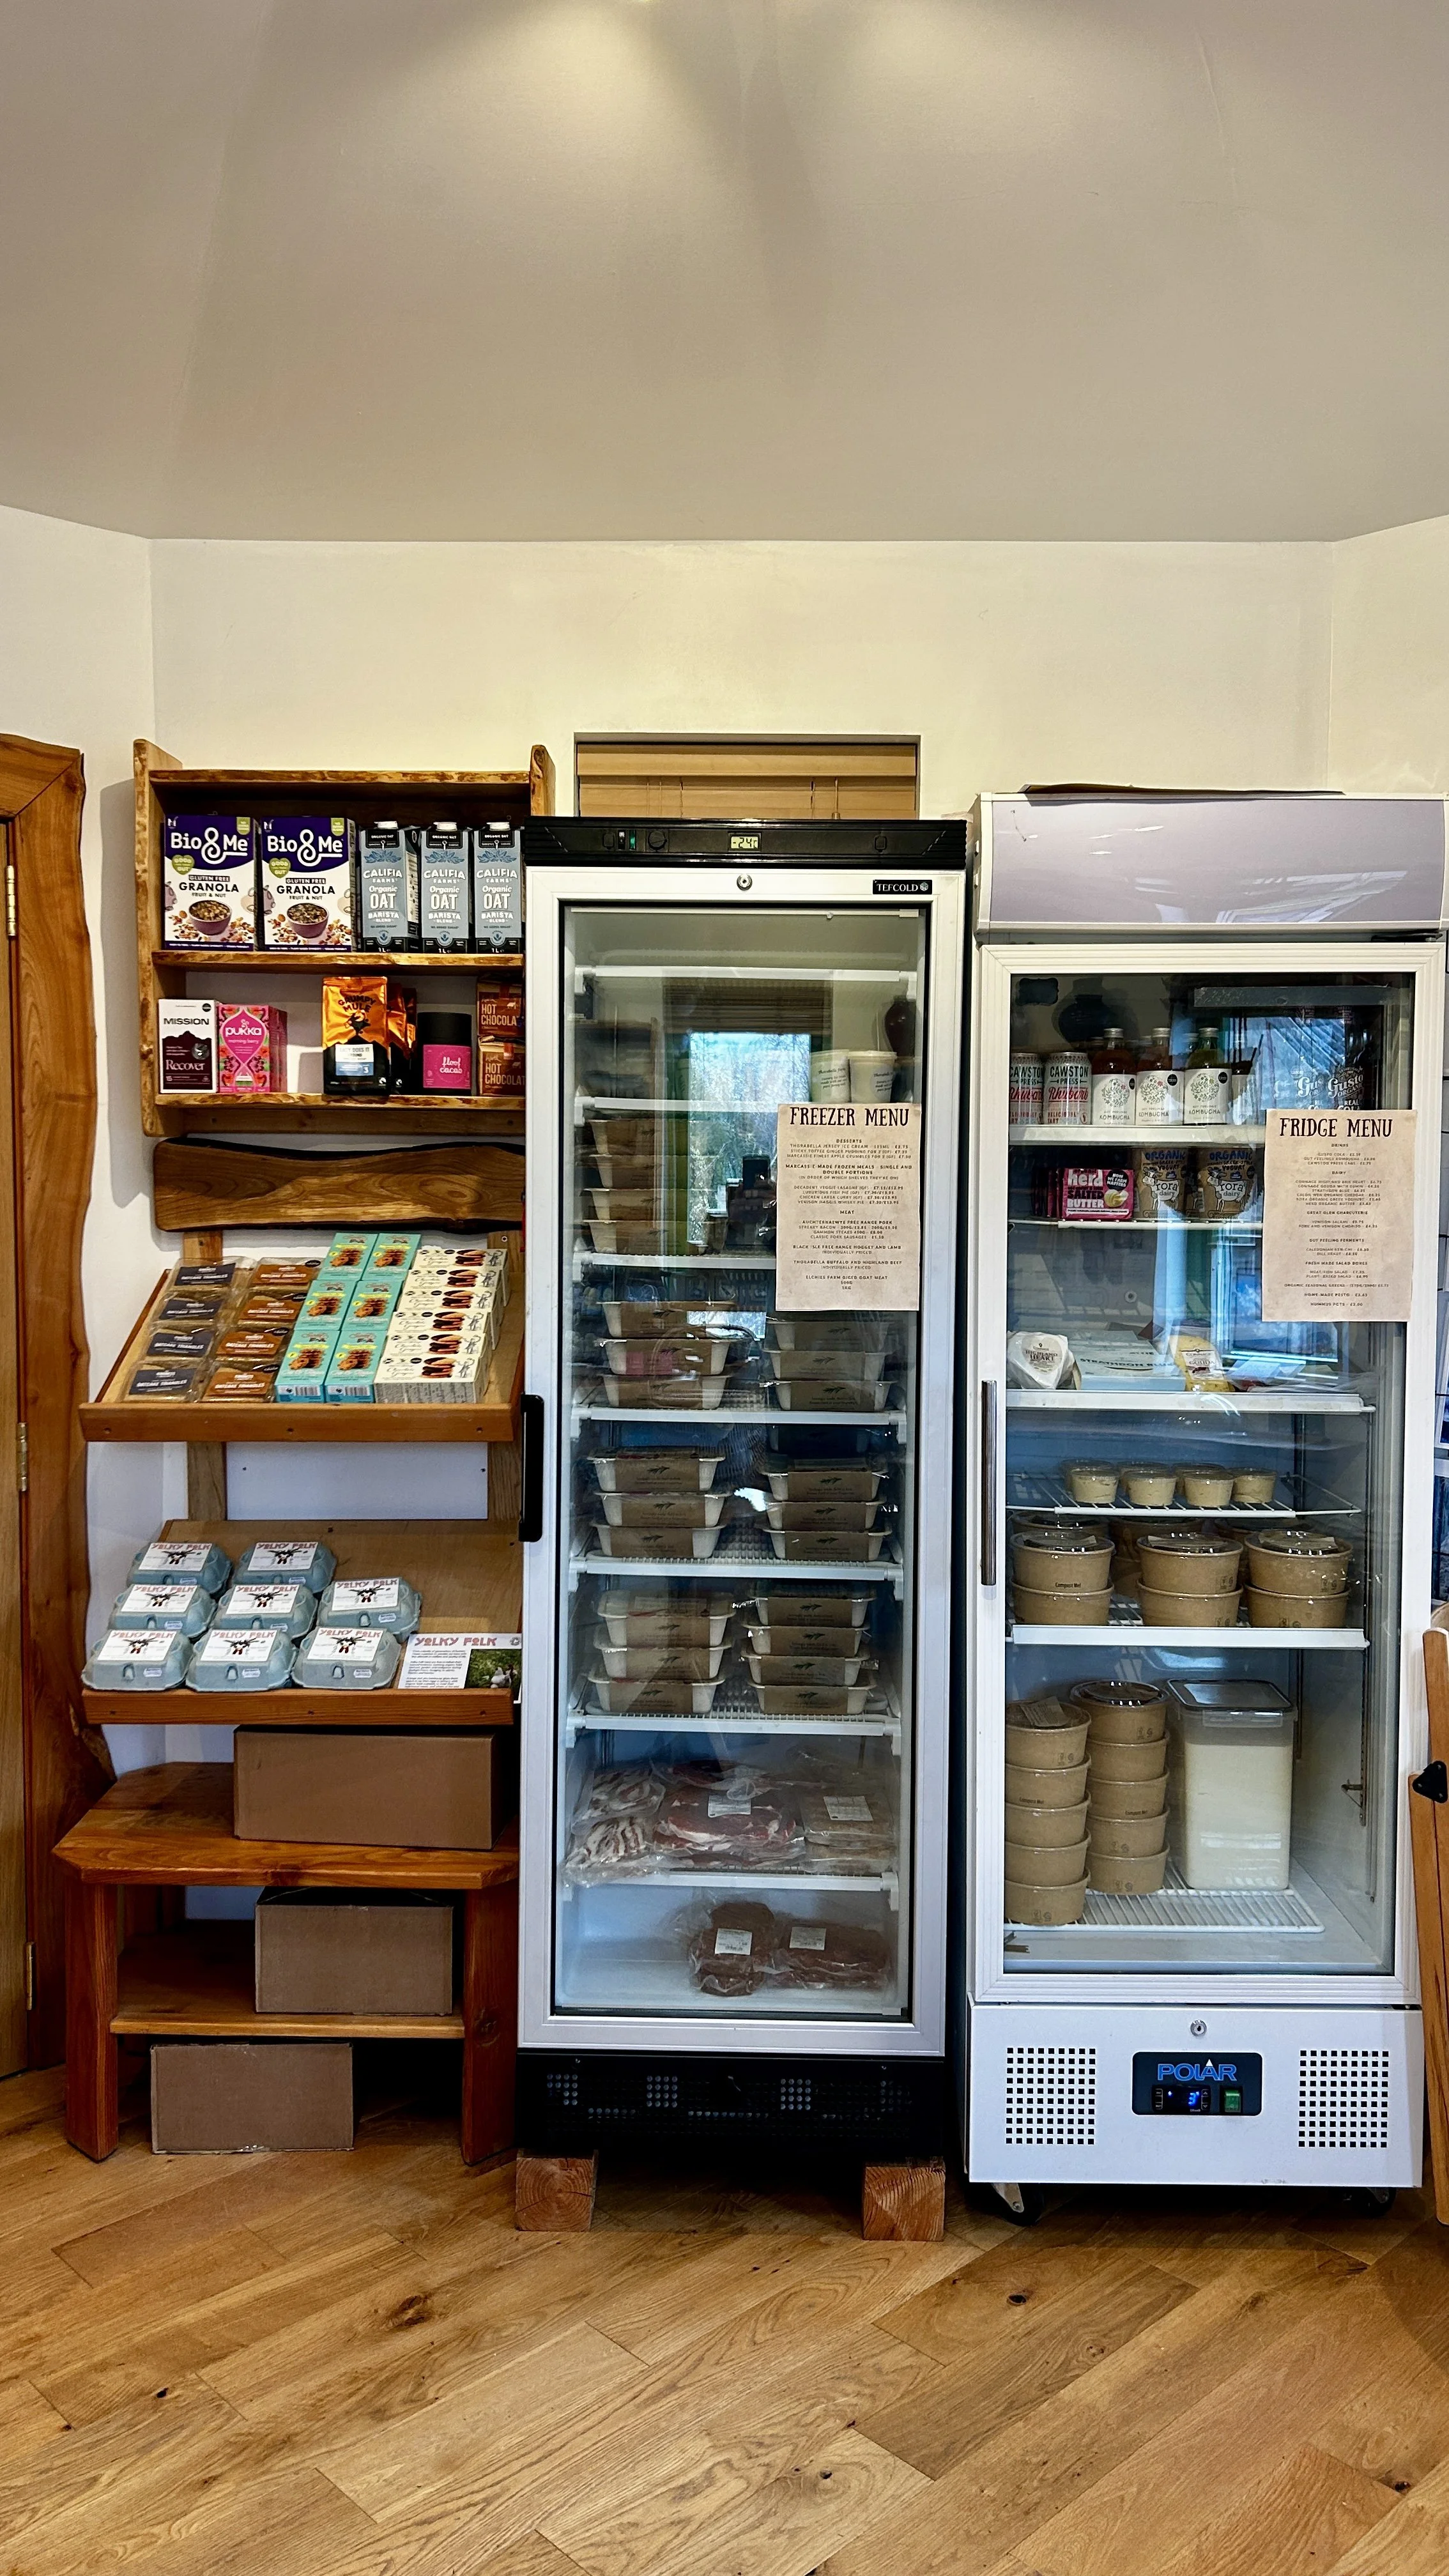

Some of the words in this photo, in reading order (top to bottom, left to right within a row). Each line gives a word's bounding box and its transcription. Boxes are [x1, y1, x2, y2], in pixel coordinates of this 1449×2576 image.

[171, 827, 248, 864] Bio&Me
[267, 829, 343, 867] Bio&Me
[363, 868, 402, 879] CALIFIA
[424, 869, 466, 880] CALIFIA
[477, 868, 518, 879] CALIFIA
[179, 882, 239, 892] GRANOLA
[277, 885, 335, 894] GRANOLA
[429, 885, 460, 894] Organic
[877, 883, 918, 892] TEFCOLD
[371, 894, 396, 909] OAT
[431, 894, 457, 910] OAT
[484, 894, 510, 909] OAT
[342, 1002, 371, 1013] MULE
[481, 1004, 497, 1014] HOT
[481, 1015, 518, 1026] CHOCOLA
[225, 1027, 262, 1037] pukka
[165, 1059, 205, 1071] Recover
[485, 1063, 502, 1074] HOT
[1050, 1066, 1089, 1078] CAWSTON
[1328, 1073, 1363, 1099] Gusto
[790, 1107, 855, 1126] FREEZER
[864, 1108, 910, 1126] MENU
[1279, 1118, 1337, 1137] FRIDGE
[1347, 1119, 1393, 1137] MENU
[1068, 1169, 1103, 1186] herd
[1156, 1183, 1178, 1192] rora
[1220, 1182, 1243, 1192] rora
[1067, 1189, 1104, 1199] SALTED
[1067, 1199, 1104, 1208] BUTTER
[415, 1637, 459, 1646] YOLKY
[463, 1637, 497, 1646] FOLK
[1158, 2060, 1237, 2081] POLAR
